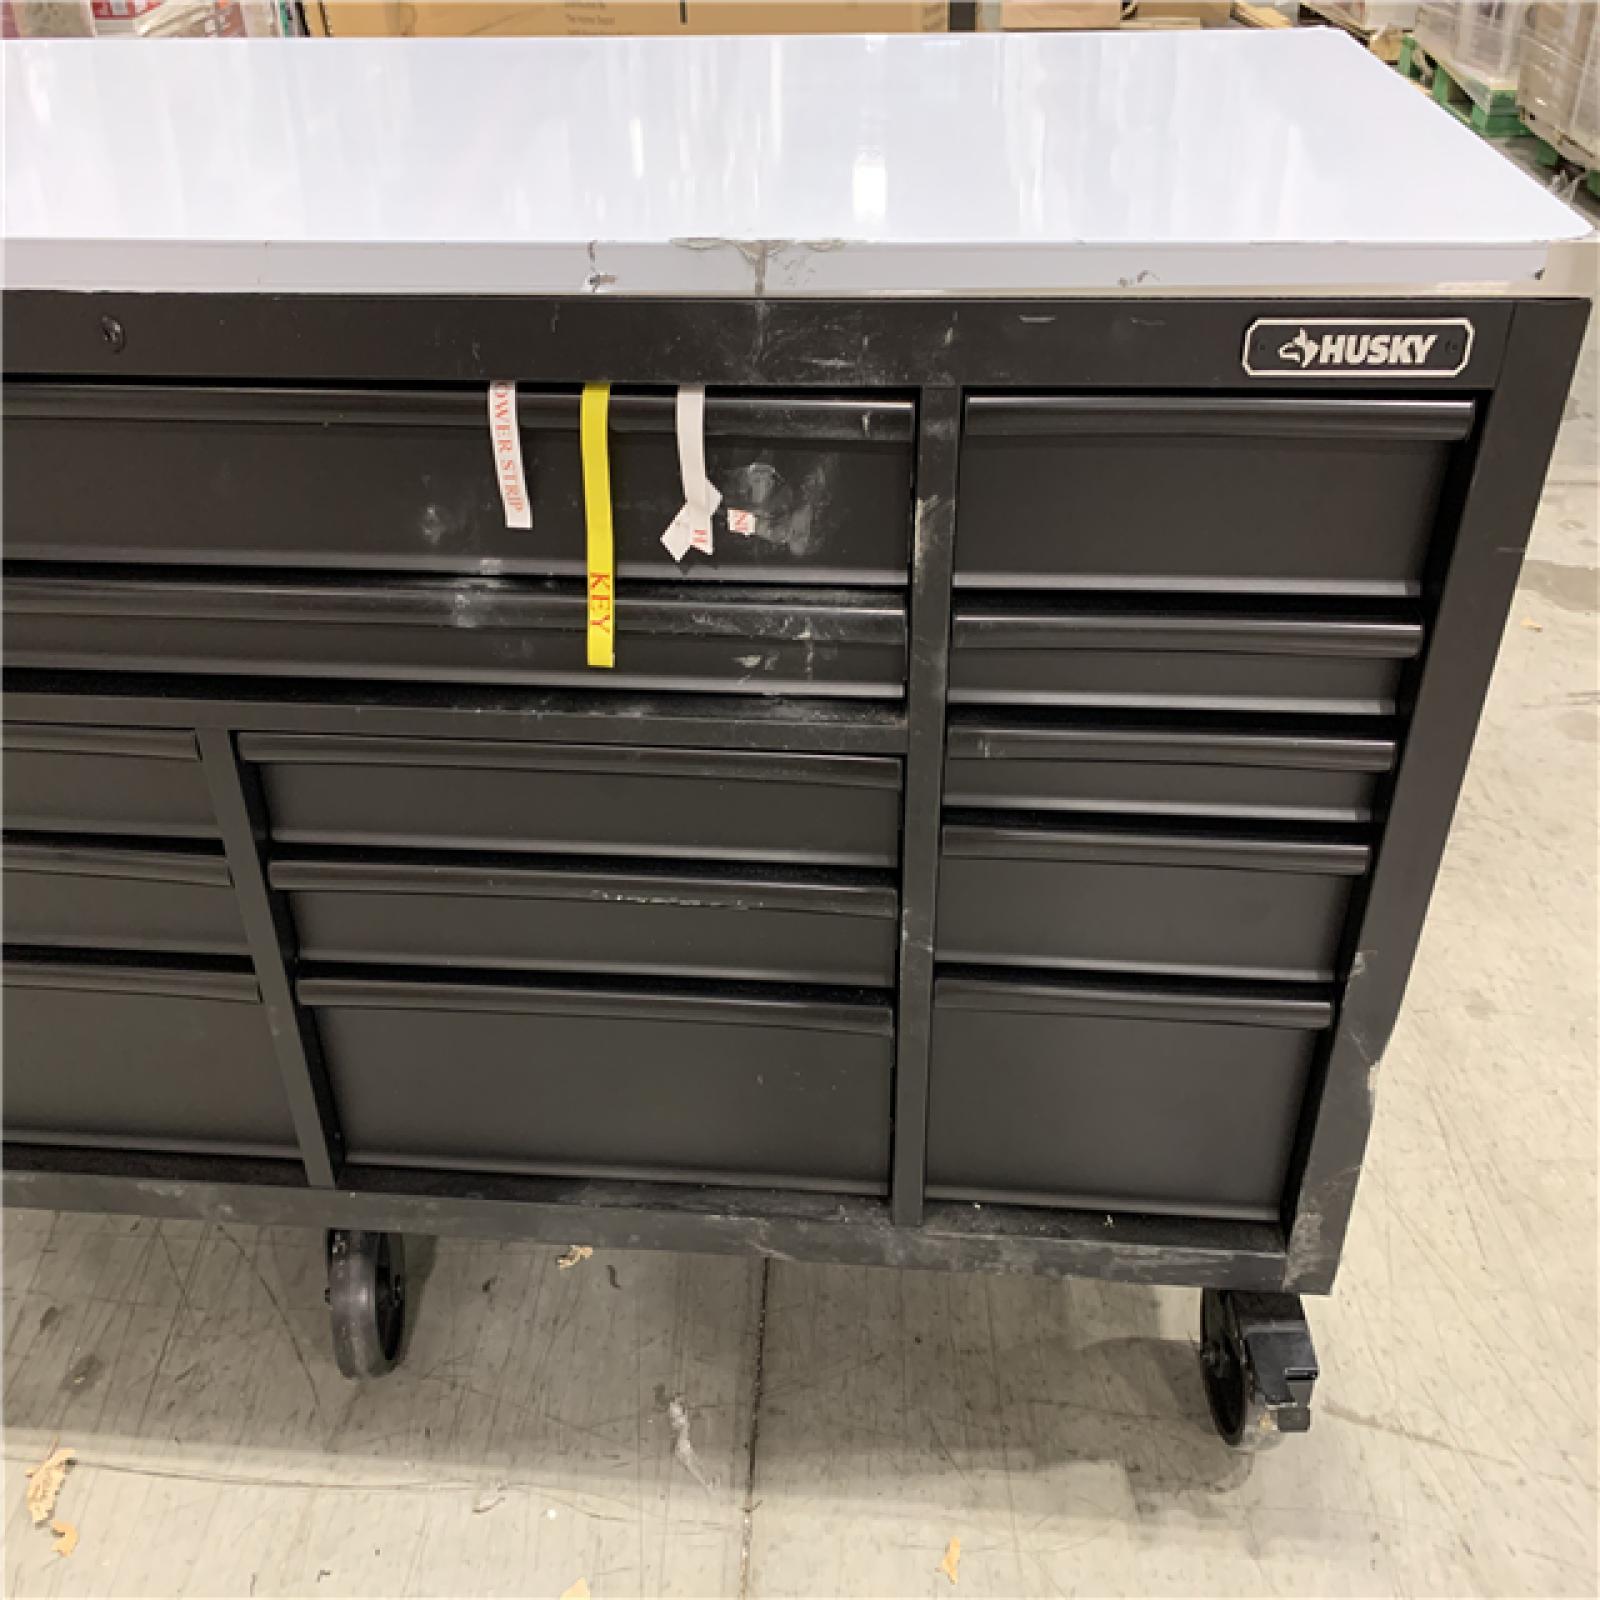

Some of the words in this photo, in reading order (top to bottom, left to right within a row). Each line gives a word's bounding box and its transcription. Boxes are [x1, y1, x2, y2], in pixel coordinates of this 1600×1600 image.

[1319, 334, 1438, 364] HUSKY
[501, 459, 525, 512] STRIP
[589, 572, 611, 634] KEY
